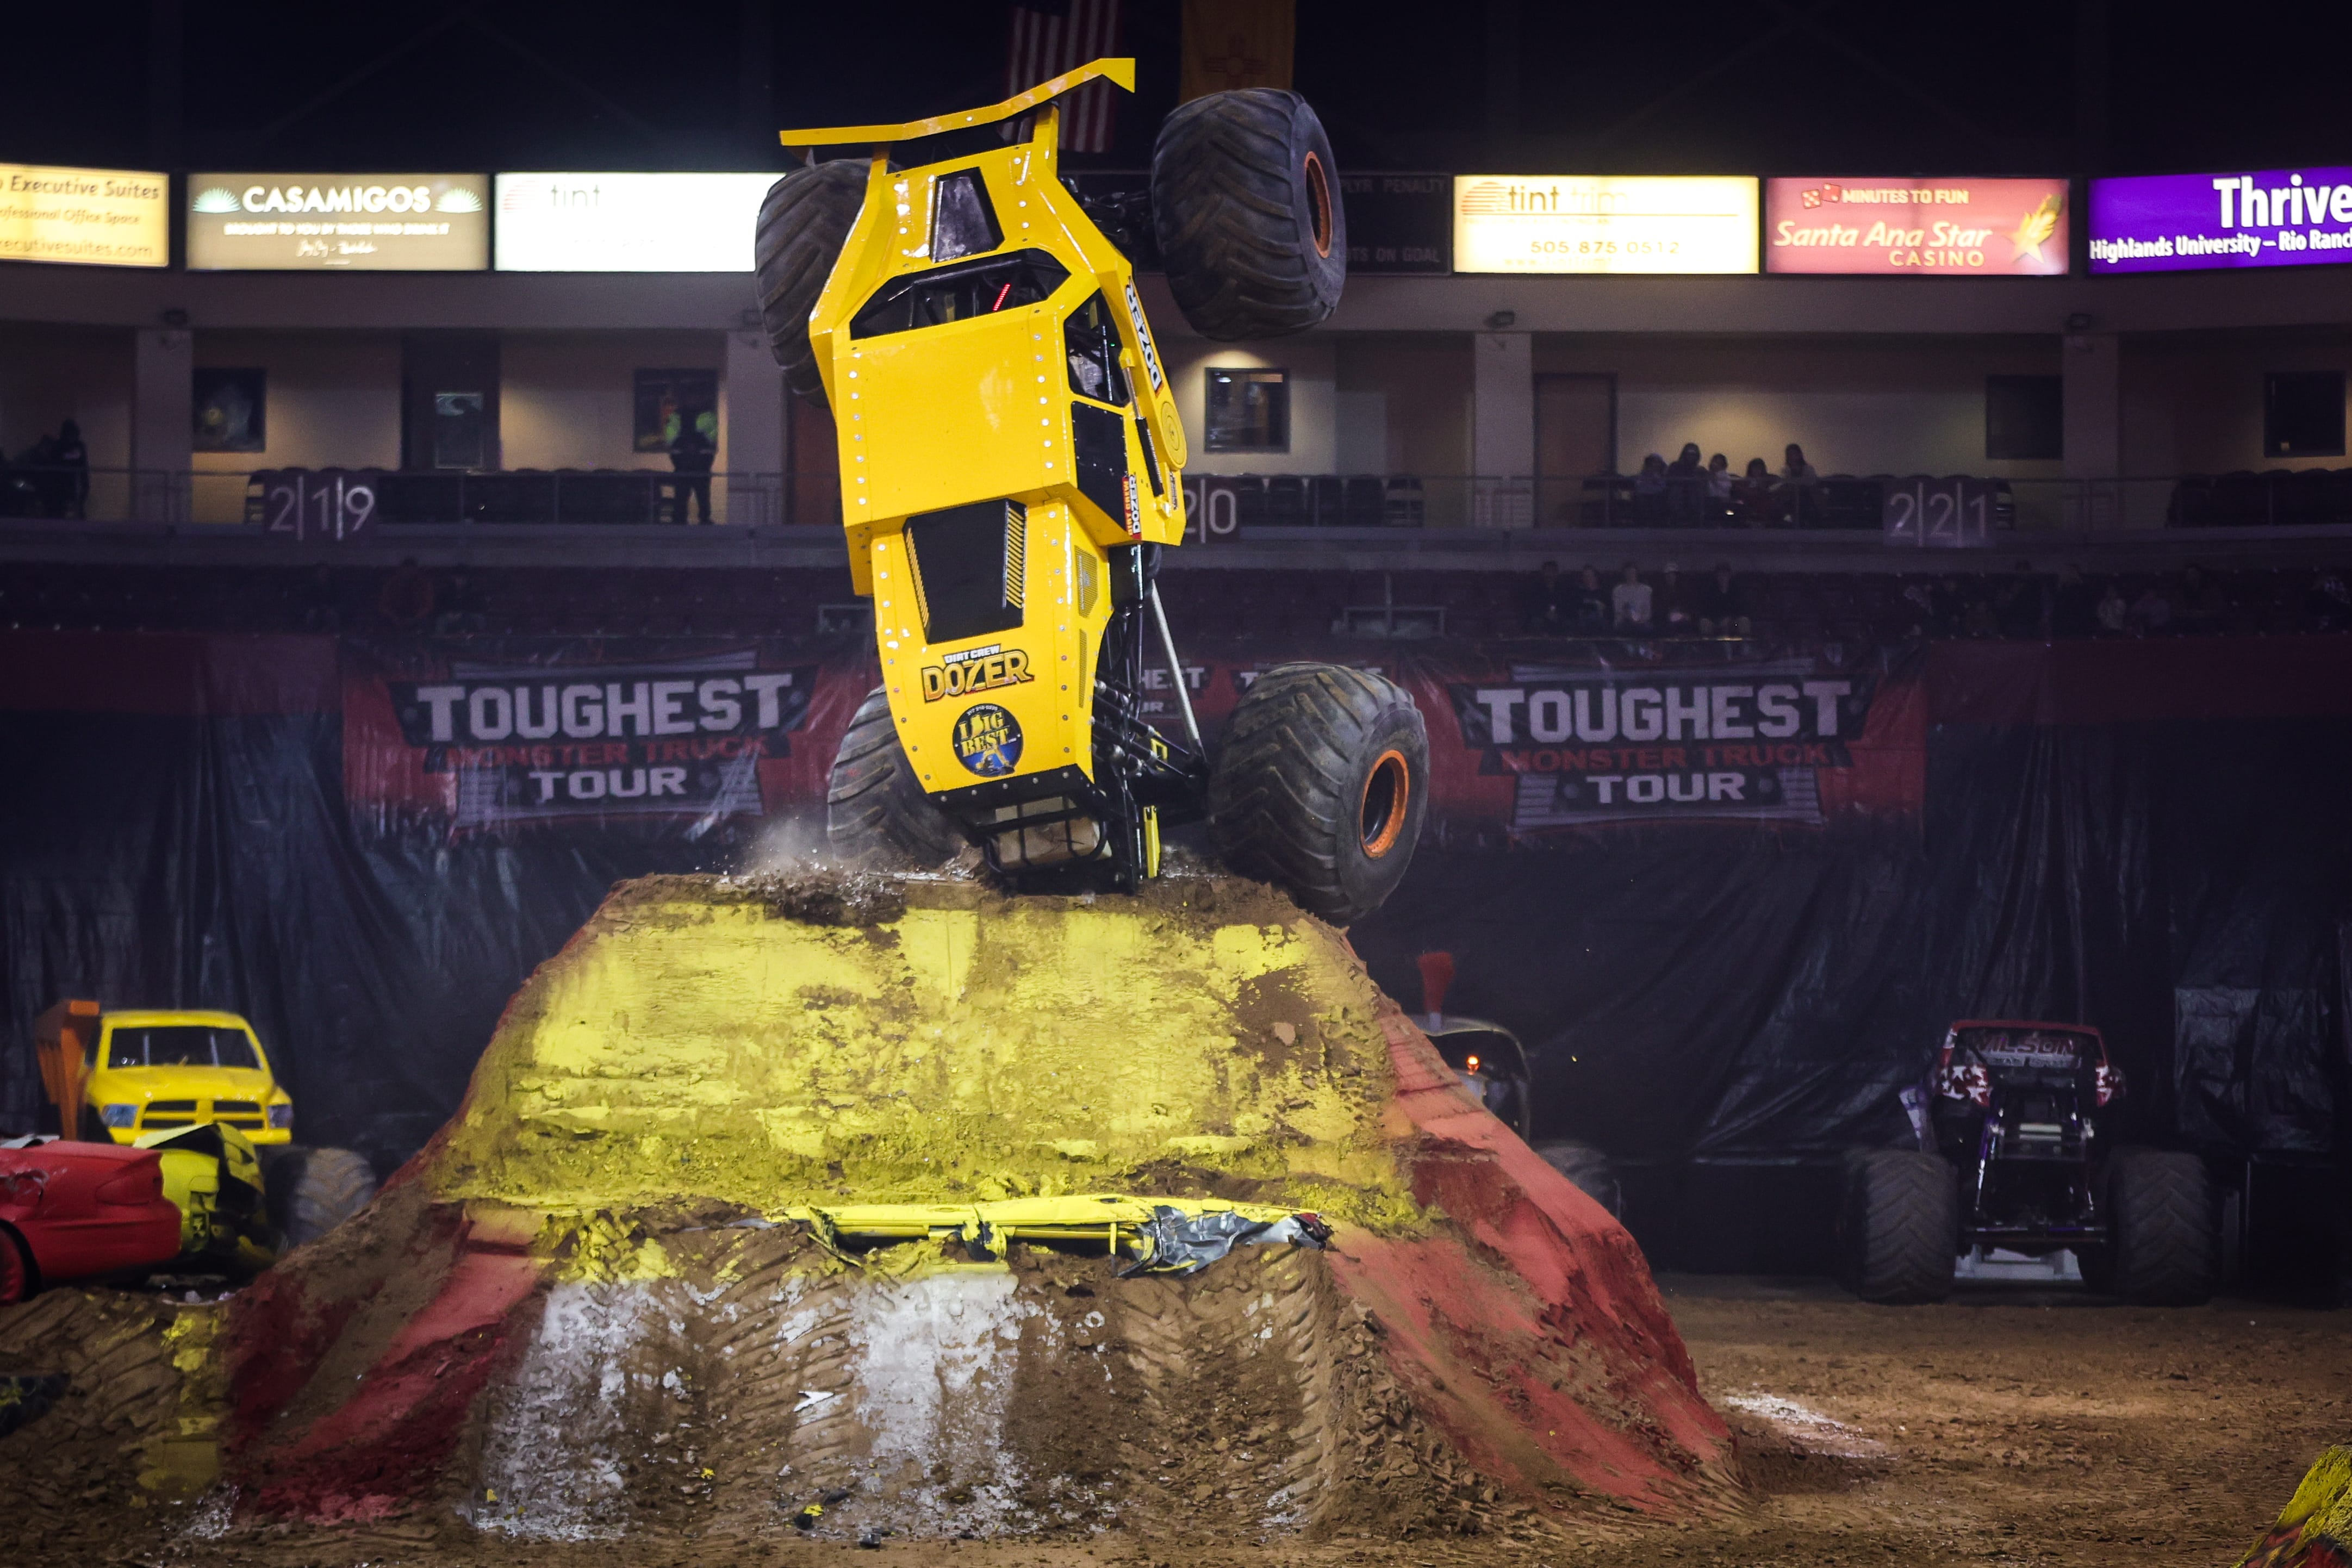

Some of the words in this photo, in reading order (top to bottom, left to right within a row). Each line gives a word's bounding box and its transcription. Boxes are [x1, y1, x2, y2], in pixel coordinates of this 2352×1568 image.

[11, 175, 98, 196] Executive
[103, 180, 159, 200] Suites
[242, 185, 431, 213] CASAMIGOS
[551, 184, 600, 207] tint
[1509, 186, 1559, 211] tint
[1841, 189, 1909, 204] MINUTES
[1910, 189, 1932, 204] TO
[1934, 189, 1970, 204] FUN
[2213, 173, 2352, 228] Thrive
[1774, 220, 1860, 247] Santa
[1862, 220, 1925, 247] Ana
[1928, 220, 1993, 247] Star
[2089, 235, 2174, 264] Highlands
[2175, 232, 2261, 257] University
[2279, 230, 2307, 251] Rio
[1889, 250, 1985, 266] CASINO
[1124, 282, 1163, 391] DOZER
[1128, 475, 1141, 533] DOZER
[944, 652, 970, 664] DIRT
[970, 645, 1000, 659] CREW
[922, 650, 1034, 702] DOZER
[417, 674, 792, 742] TOUGHEST
[1476, 681, 1851, 744] TOUGHEST
[446, 740, 629, 768] MONSTER
[646, 736, 769, 761] TRUCK
[960, 728, 1009, 757] BEST
[1501, 745, 1686, 773] MONSTER
[1704, 743, 1830, 767] TRUCK
[528, 767, 687, 801] TOUR
[1585, 772, 1745, 804] TOUR
